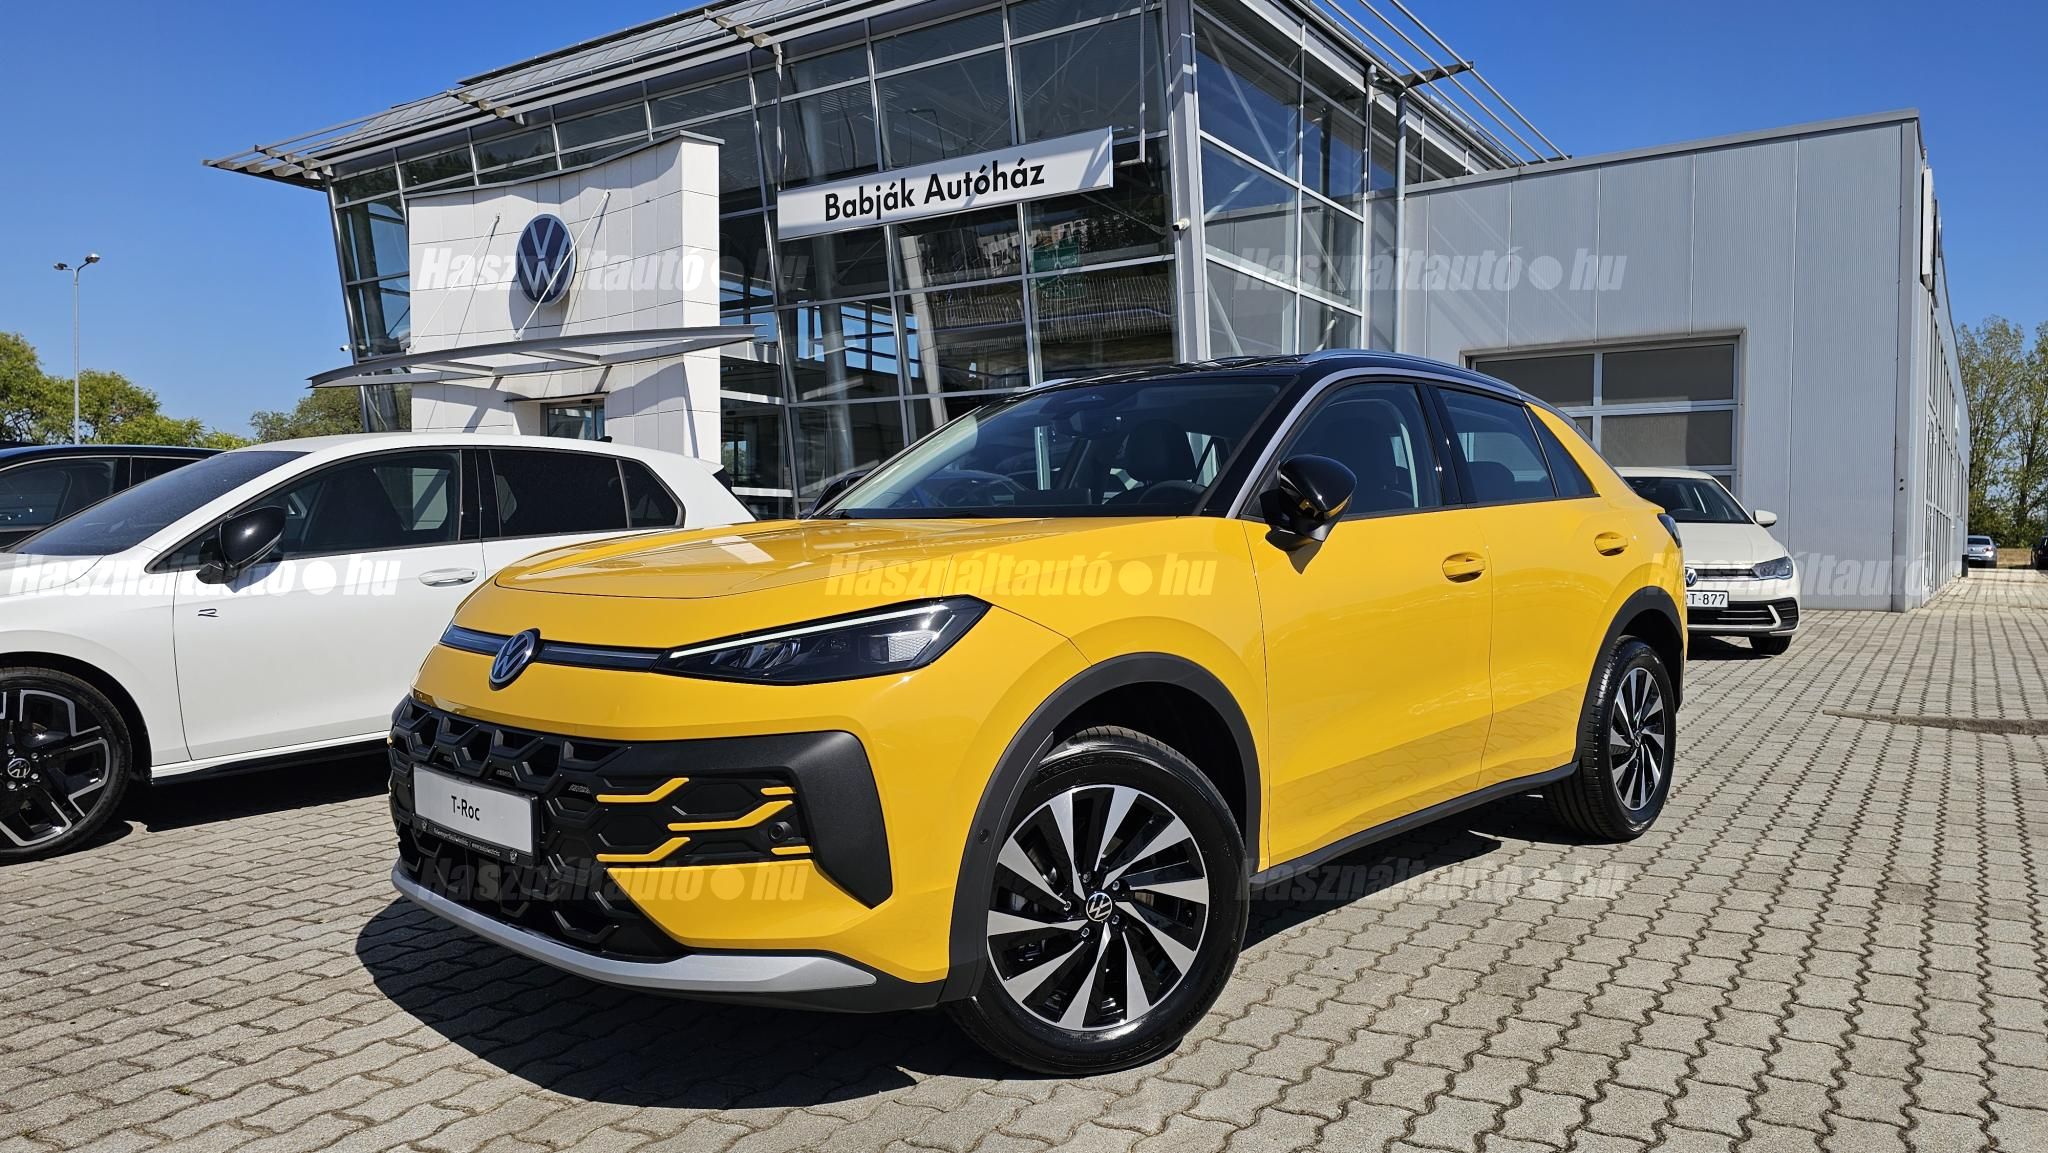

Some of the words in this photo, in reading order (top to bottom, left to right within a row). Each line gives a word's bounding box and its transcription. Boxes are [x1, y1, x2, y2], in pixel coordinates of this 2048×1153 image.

[824, 177, 916, 221] Babják
[923, 157, 1045, 205] Autóház
[1686, 593, 1726, 605] T-877
[451, 795, 480, 821] T-Roc
